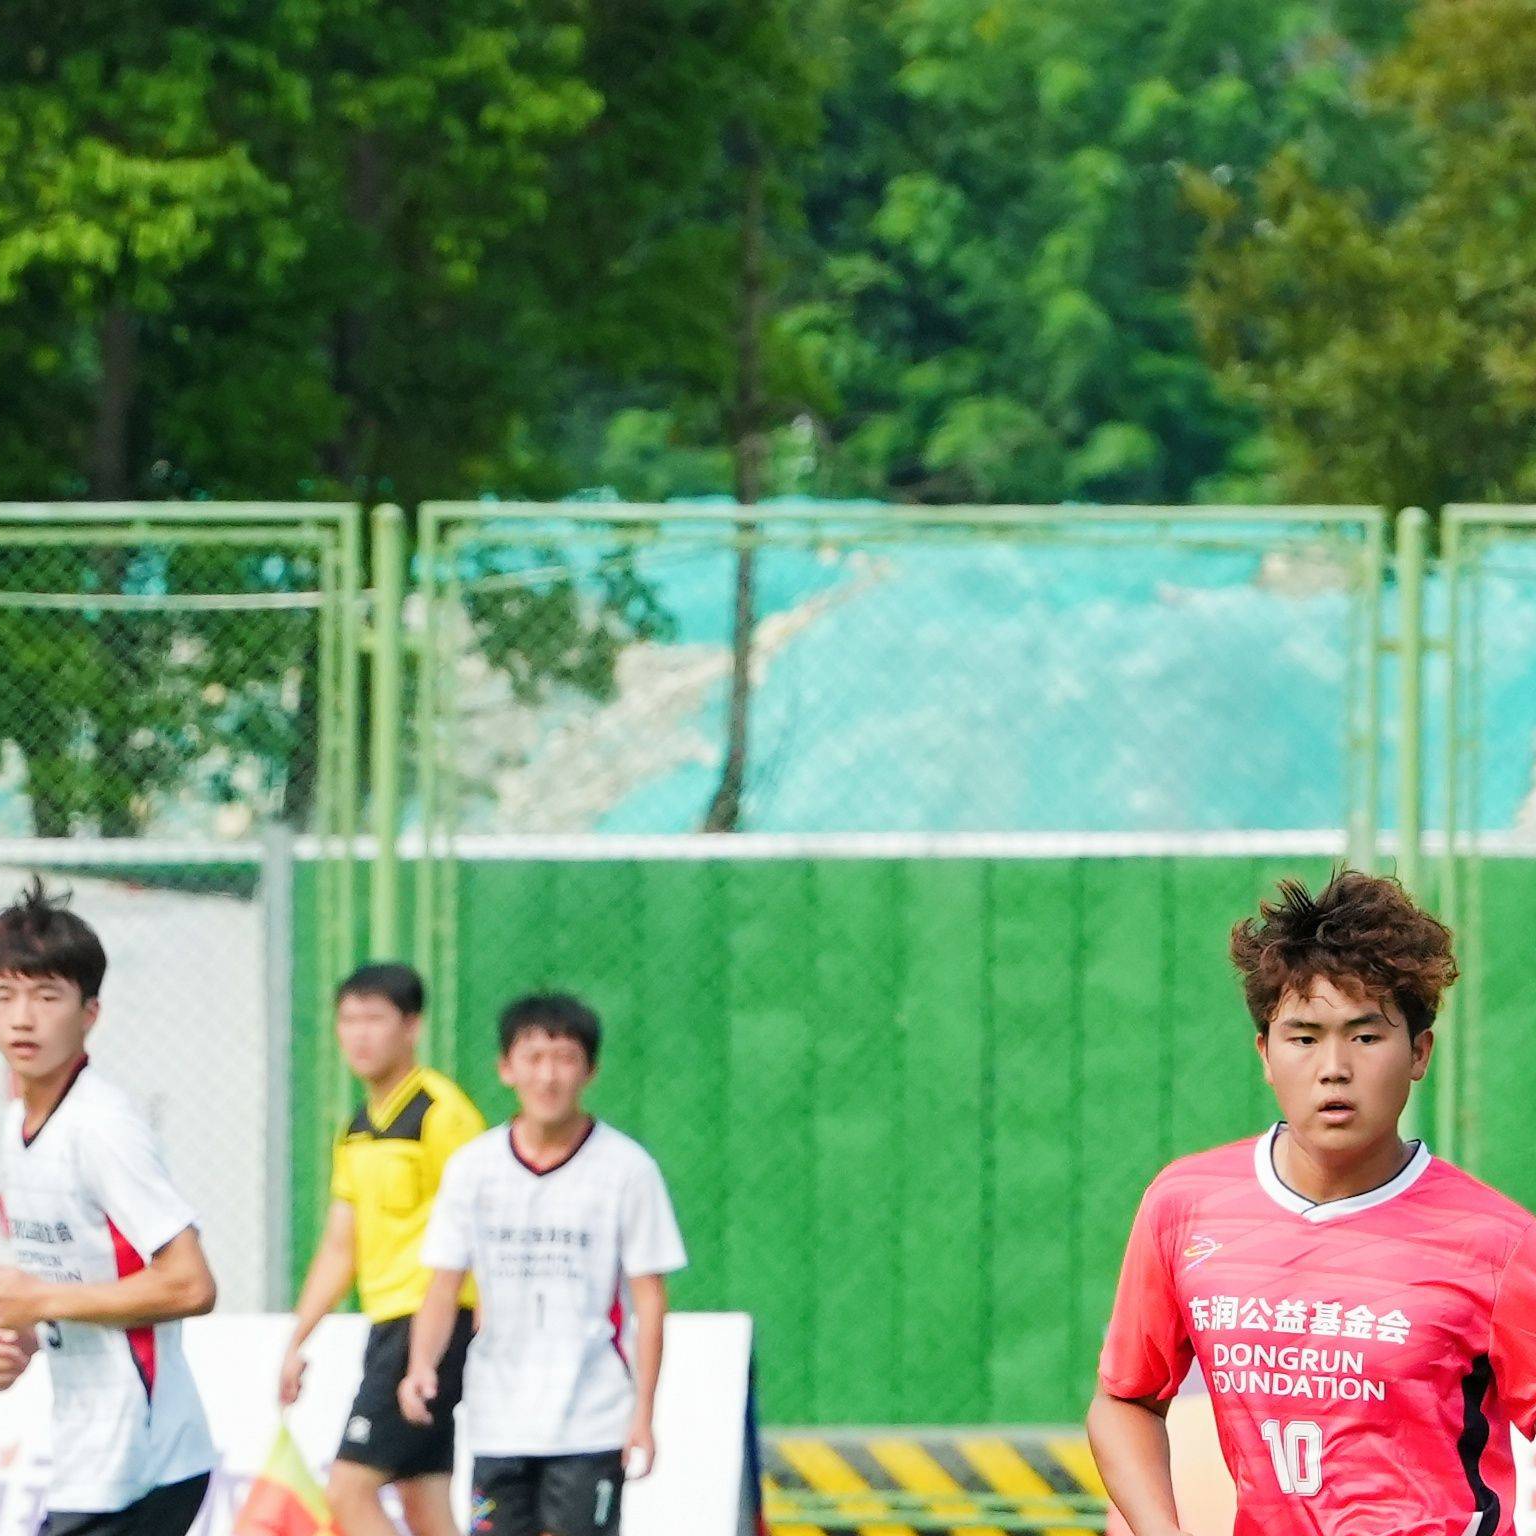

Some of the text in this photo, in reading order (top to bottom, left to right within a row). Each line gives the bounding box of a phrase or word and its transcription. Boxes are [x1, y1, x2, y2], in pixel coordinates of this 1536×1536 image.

[1189, 1295, 1411, 1344] 东润公益基金会
[1213, 1343, 1364, 1375] DONGRUN
[1261, 1419, 1322, 1496] 10
